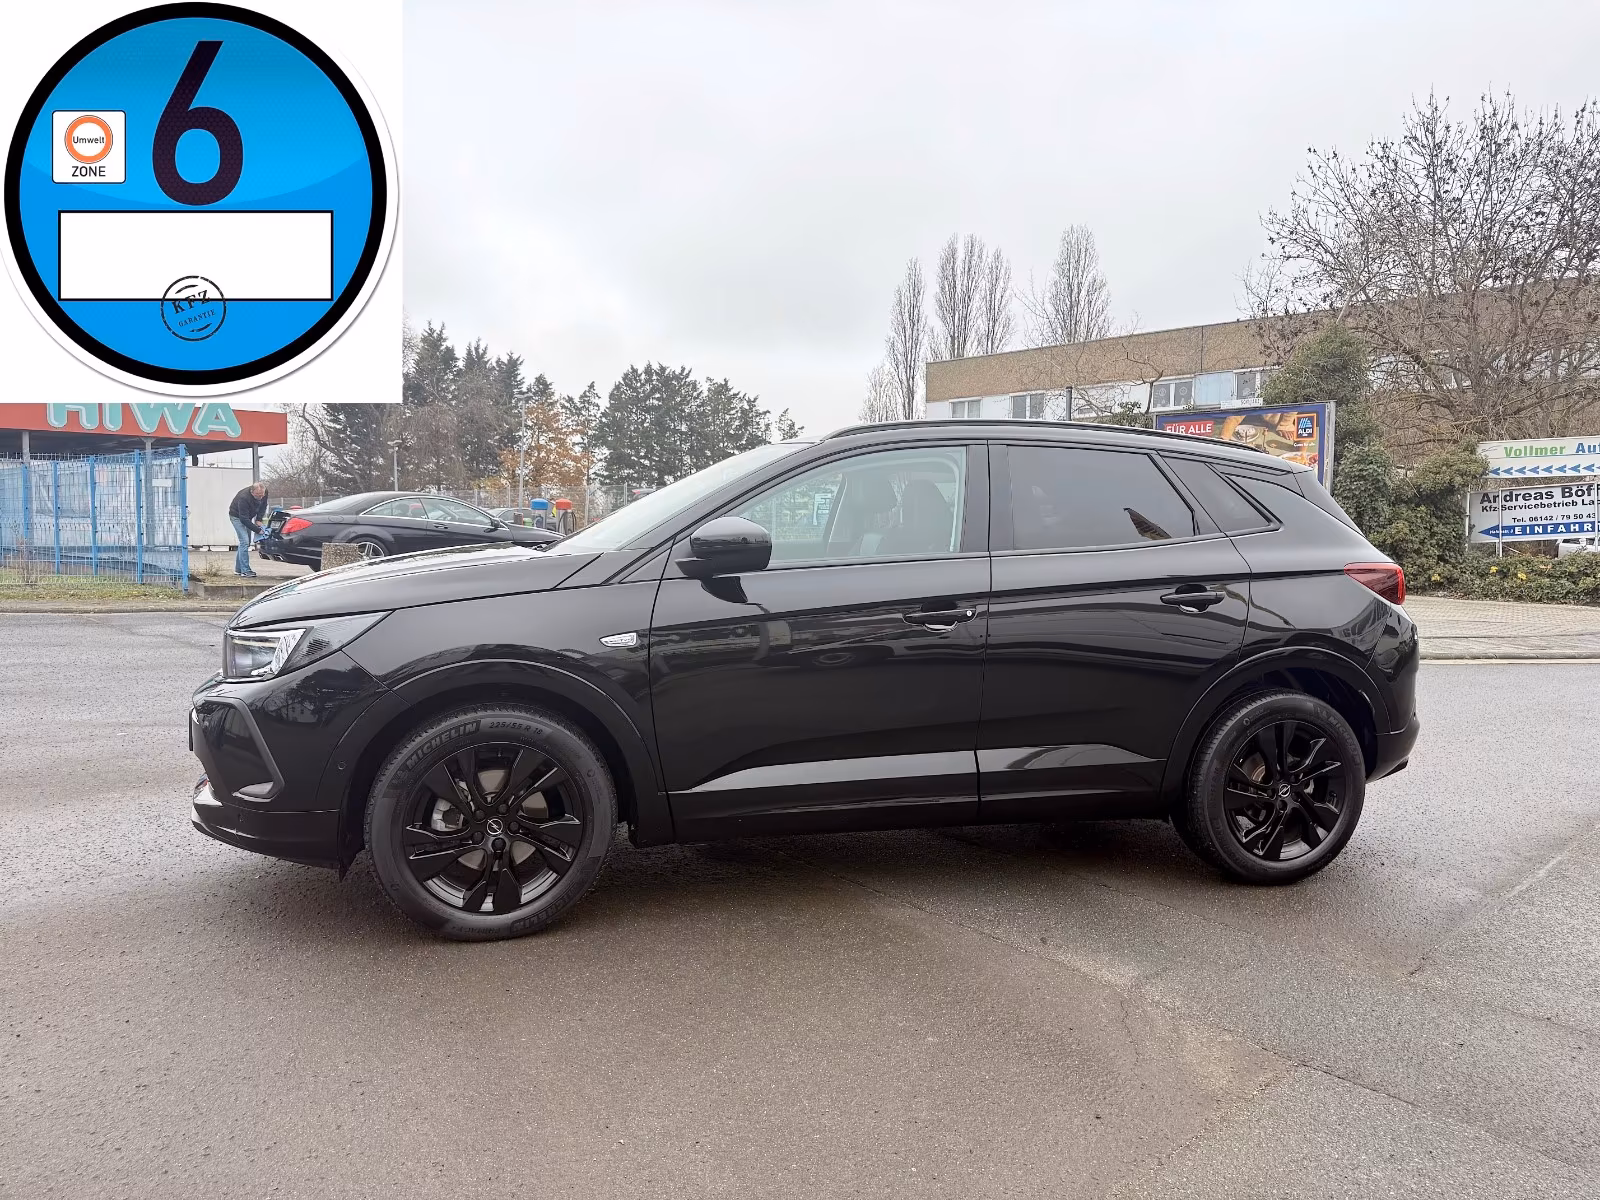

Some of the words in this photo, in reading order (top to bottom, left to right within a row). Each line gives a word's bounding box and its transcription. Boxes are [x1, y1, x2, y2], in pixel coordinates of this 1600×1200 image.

[1166, 424, 1186, 434] FÜR
[1188, 423, 1213, 434] ALLE
[1504, 445, 1566, 458] Vollmer
[1481, 499, 1578, 512] Kfz-Servicebetrieb
[1529, 515, 1554, 523] 06142
[489, 721, 522, 730] 225/55
[524, 724, 531, 732] R
[406, 721, 478, 768] MICHELIN
